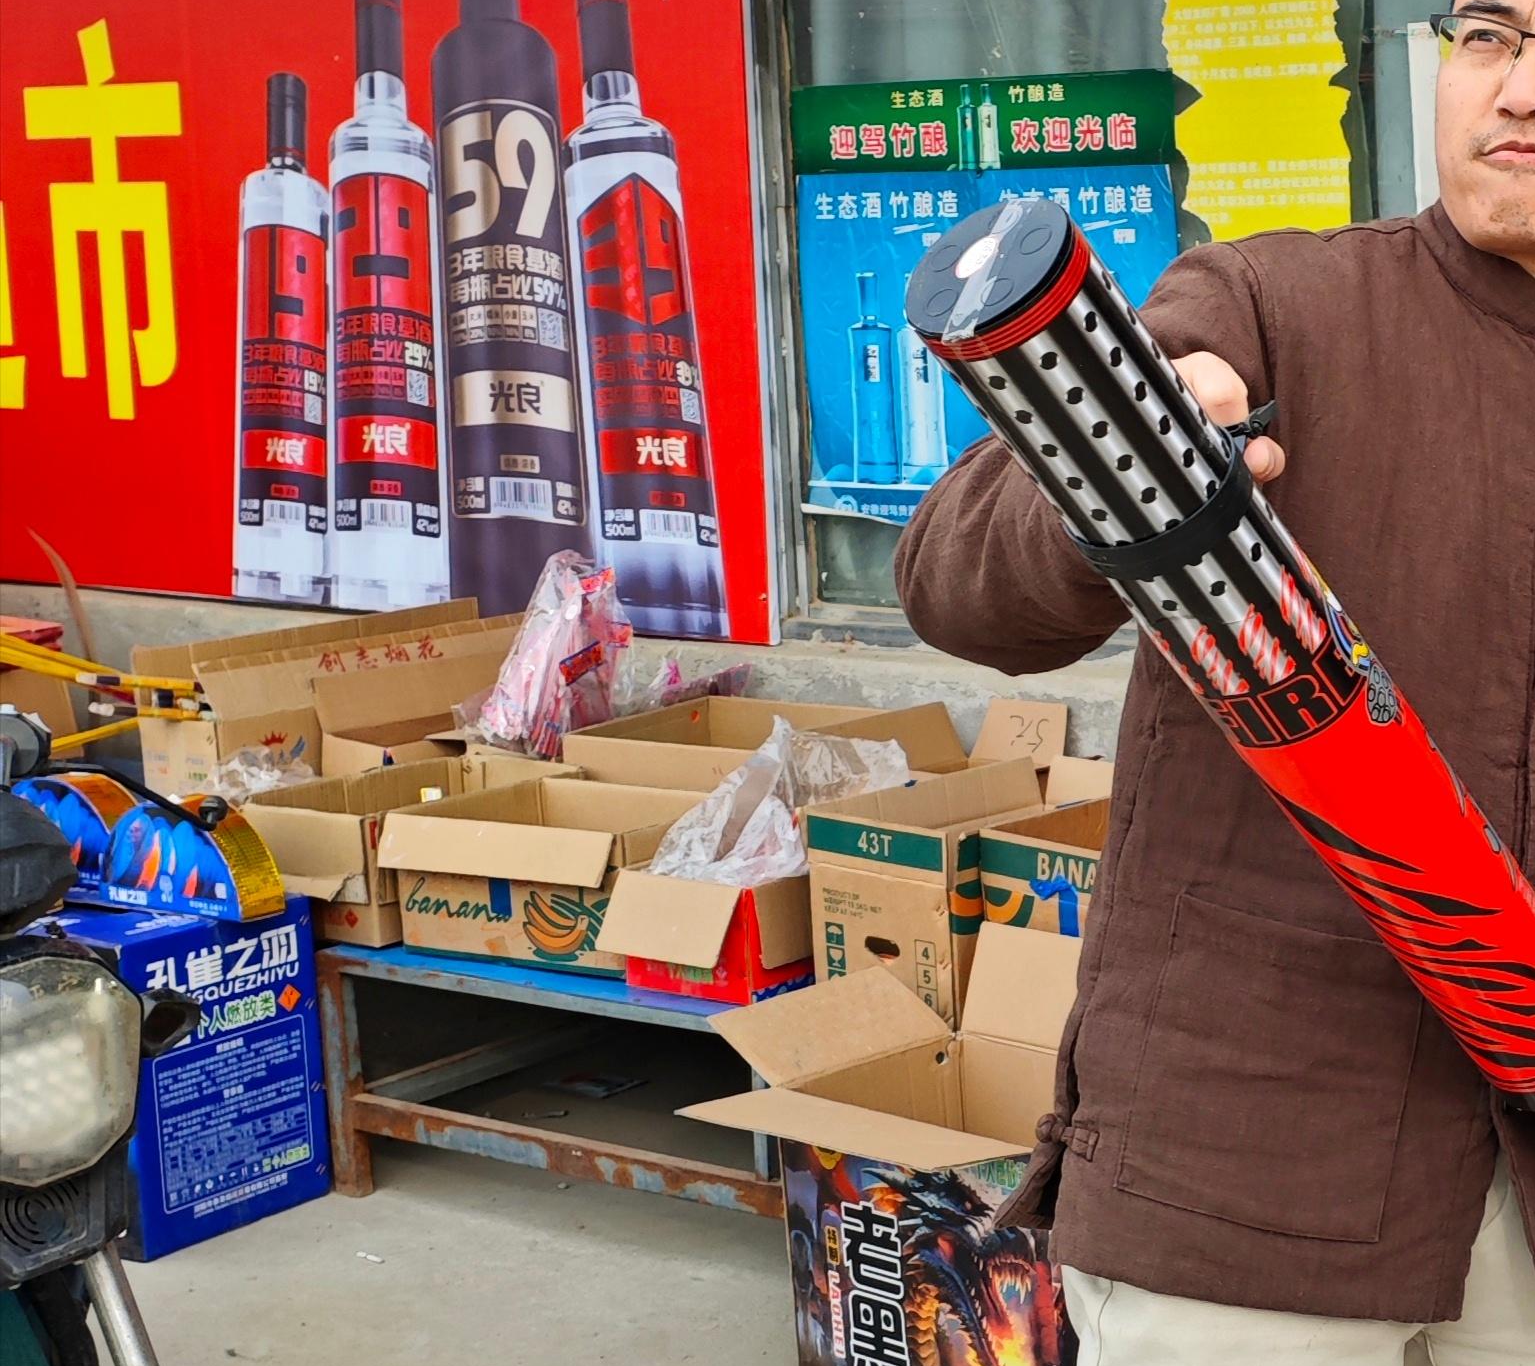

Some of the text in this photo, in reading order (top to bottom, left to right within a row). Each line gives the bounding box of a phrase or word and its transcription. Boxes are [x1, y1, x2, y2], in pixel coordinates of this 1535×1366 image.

[891, 88, 944, 109] 生态酒
[1008, 83, 1065, 103] 竹酿造
[830, 121, 948, 160] 迎驾竹酿
[1010, 113, 1137, 153] 欢迎光临
[445, 109, 556, 242] 59
[815, 190, 959, 220] 生态酒 竹酿造
[1078, 184, 1153, 214] 竹酿造
[0, 18, 182, 420] 市
[334, 175, 432, 317] 29
[580, 178, 687, 325] 39
[243, 225, 325, 351] 19
[489, 381, 544, 415] 光良
[265, 436, 307, 466] 光良
[362, 422, 412, 456] 光良
[636, 435, 688, 468] 光良
[318, 635, 444, 673] 创志烟花
[857, 830, 893, 858] 43T
[146, 924, 298, 993] 孔雀之羽
[922, 947, 930, 961] 4
[923, 970, 931, 985] 5
[924, 993, 932, 1007] 6
[828, 1269, 847, 1359] LAOHEI
